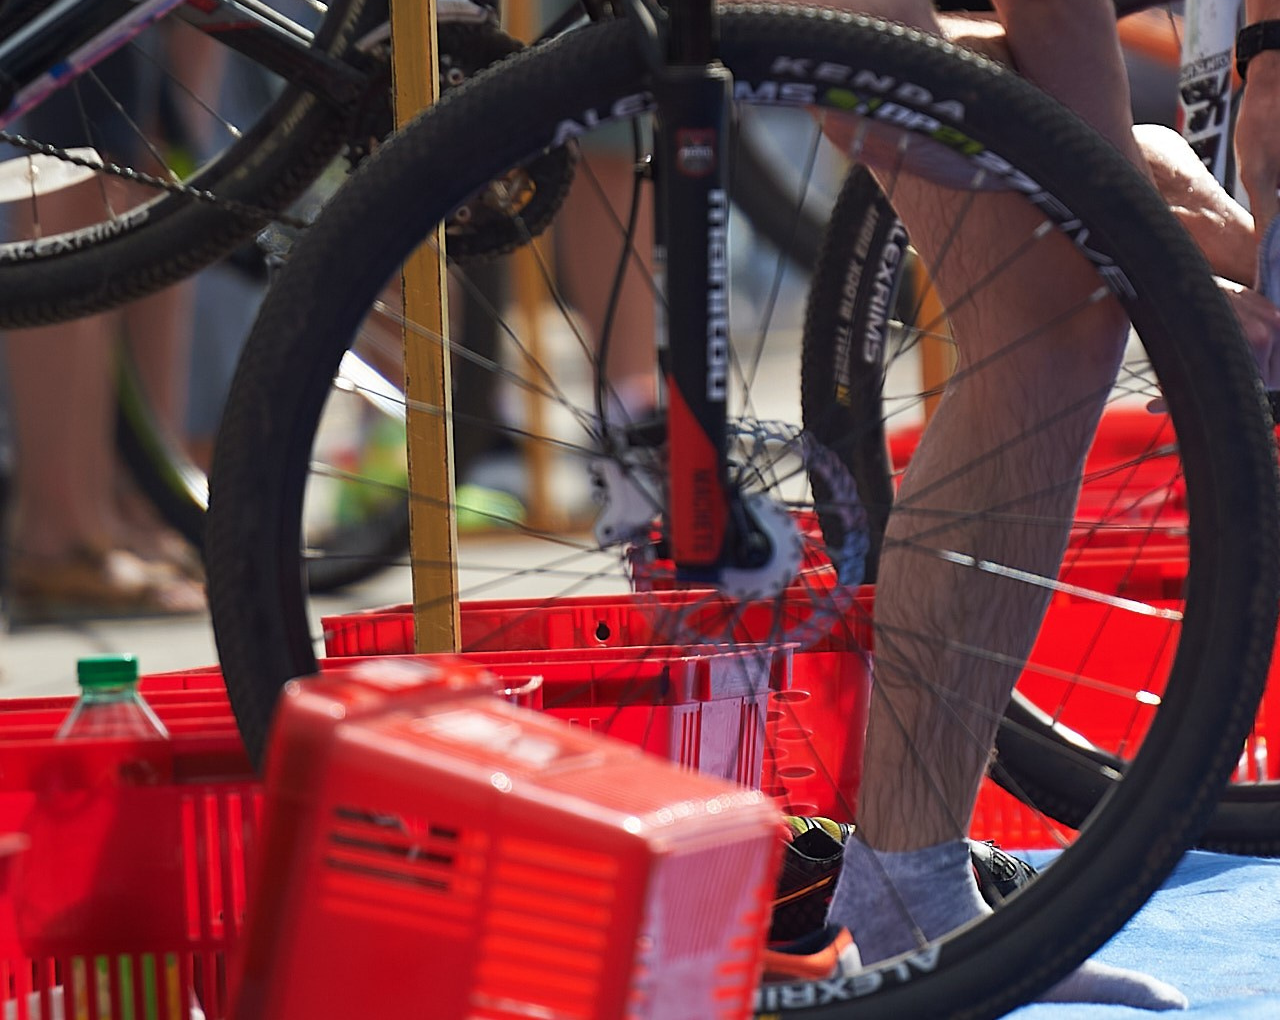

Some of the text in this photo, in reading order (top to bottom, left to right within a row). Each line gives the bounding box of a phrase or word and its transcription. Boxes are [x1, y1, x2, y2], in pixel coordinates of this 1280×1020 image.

[771, 54, 966, 121] KENDA
[707, 188, 728, 401] manitou
[839, 259, 863, 320] BLOCK
[853, 204, 879, 258] EIGHT
[863, 218, 908, 364] LEXRIMS
[753, 943, 942, 1011] ALEXRI
